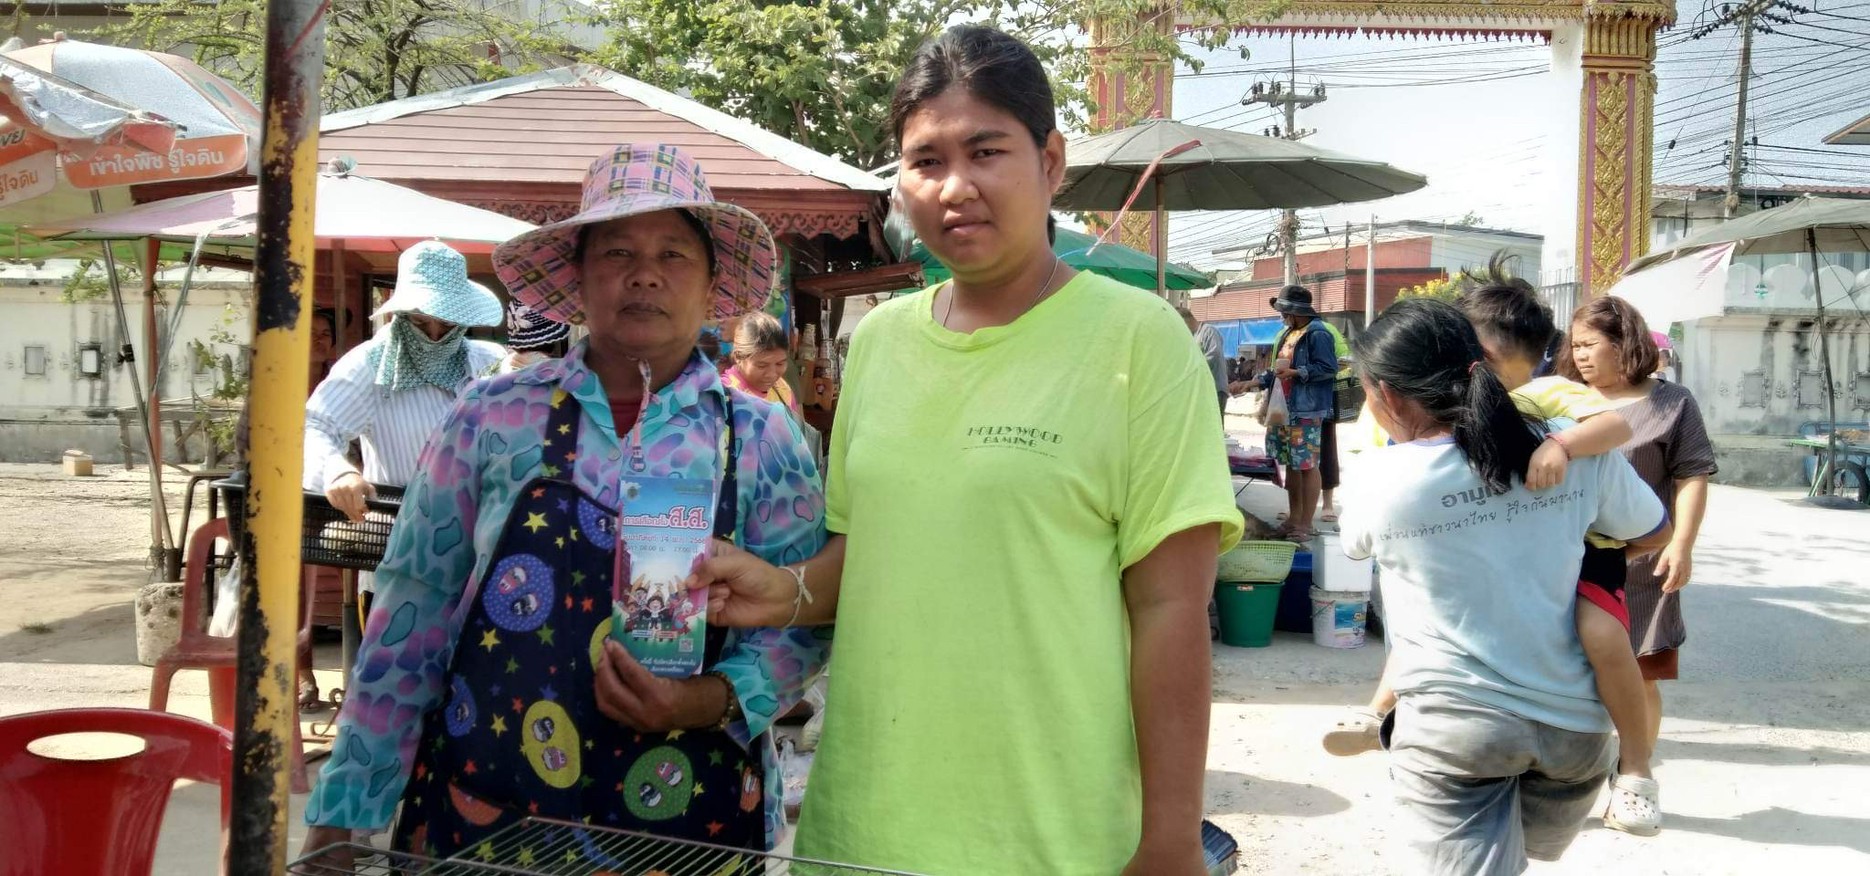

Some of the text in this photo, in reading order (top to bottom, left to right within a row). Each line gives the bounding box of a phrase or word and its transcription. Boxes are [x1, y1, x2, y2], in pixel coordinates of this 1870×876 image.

[90, 148, 224, 176] เข้าใจพืช รู้ใจดิน
[967, 425, 1063, 444] HOLLYWOOD
[983, 436, 1038, 448] GAMING
